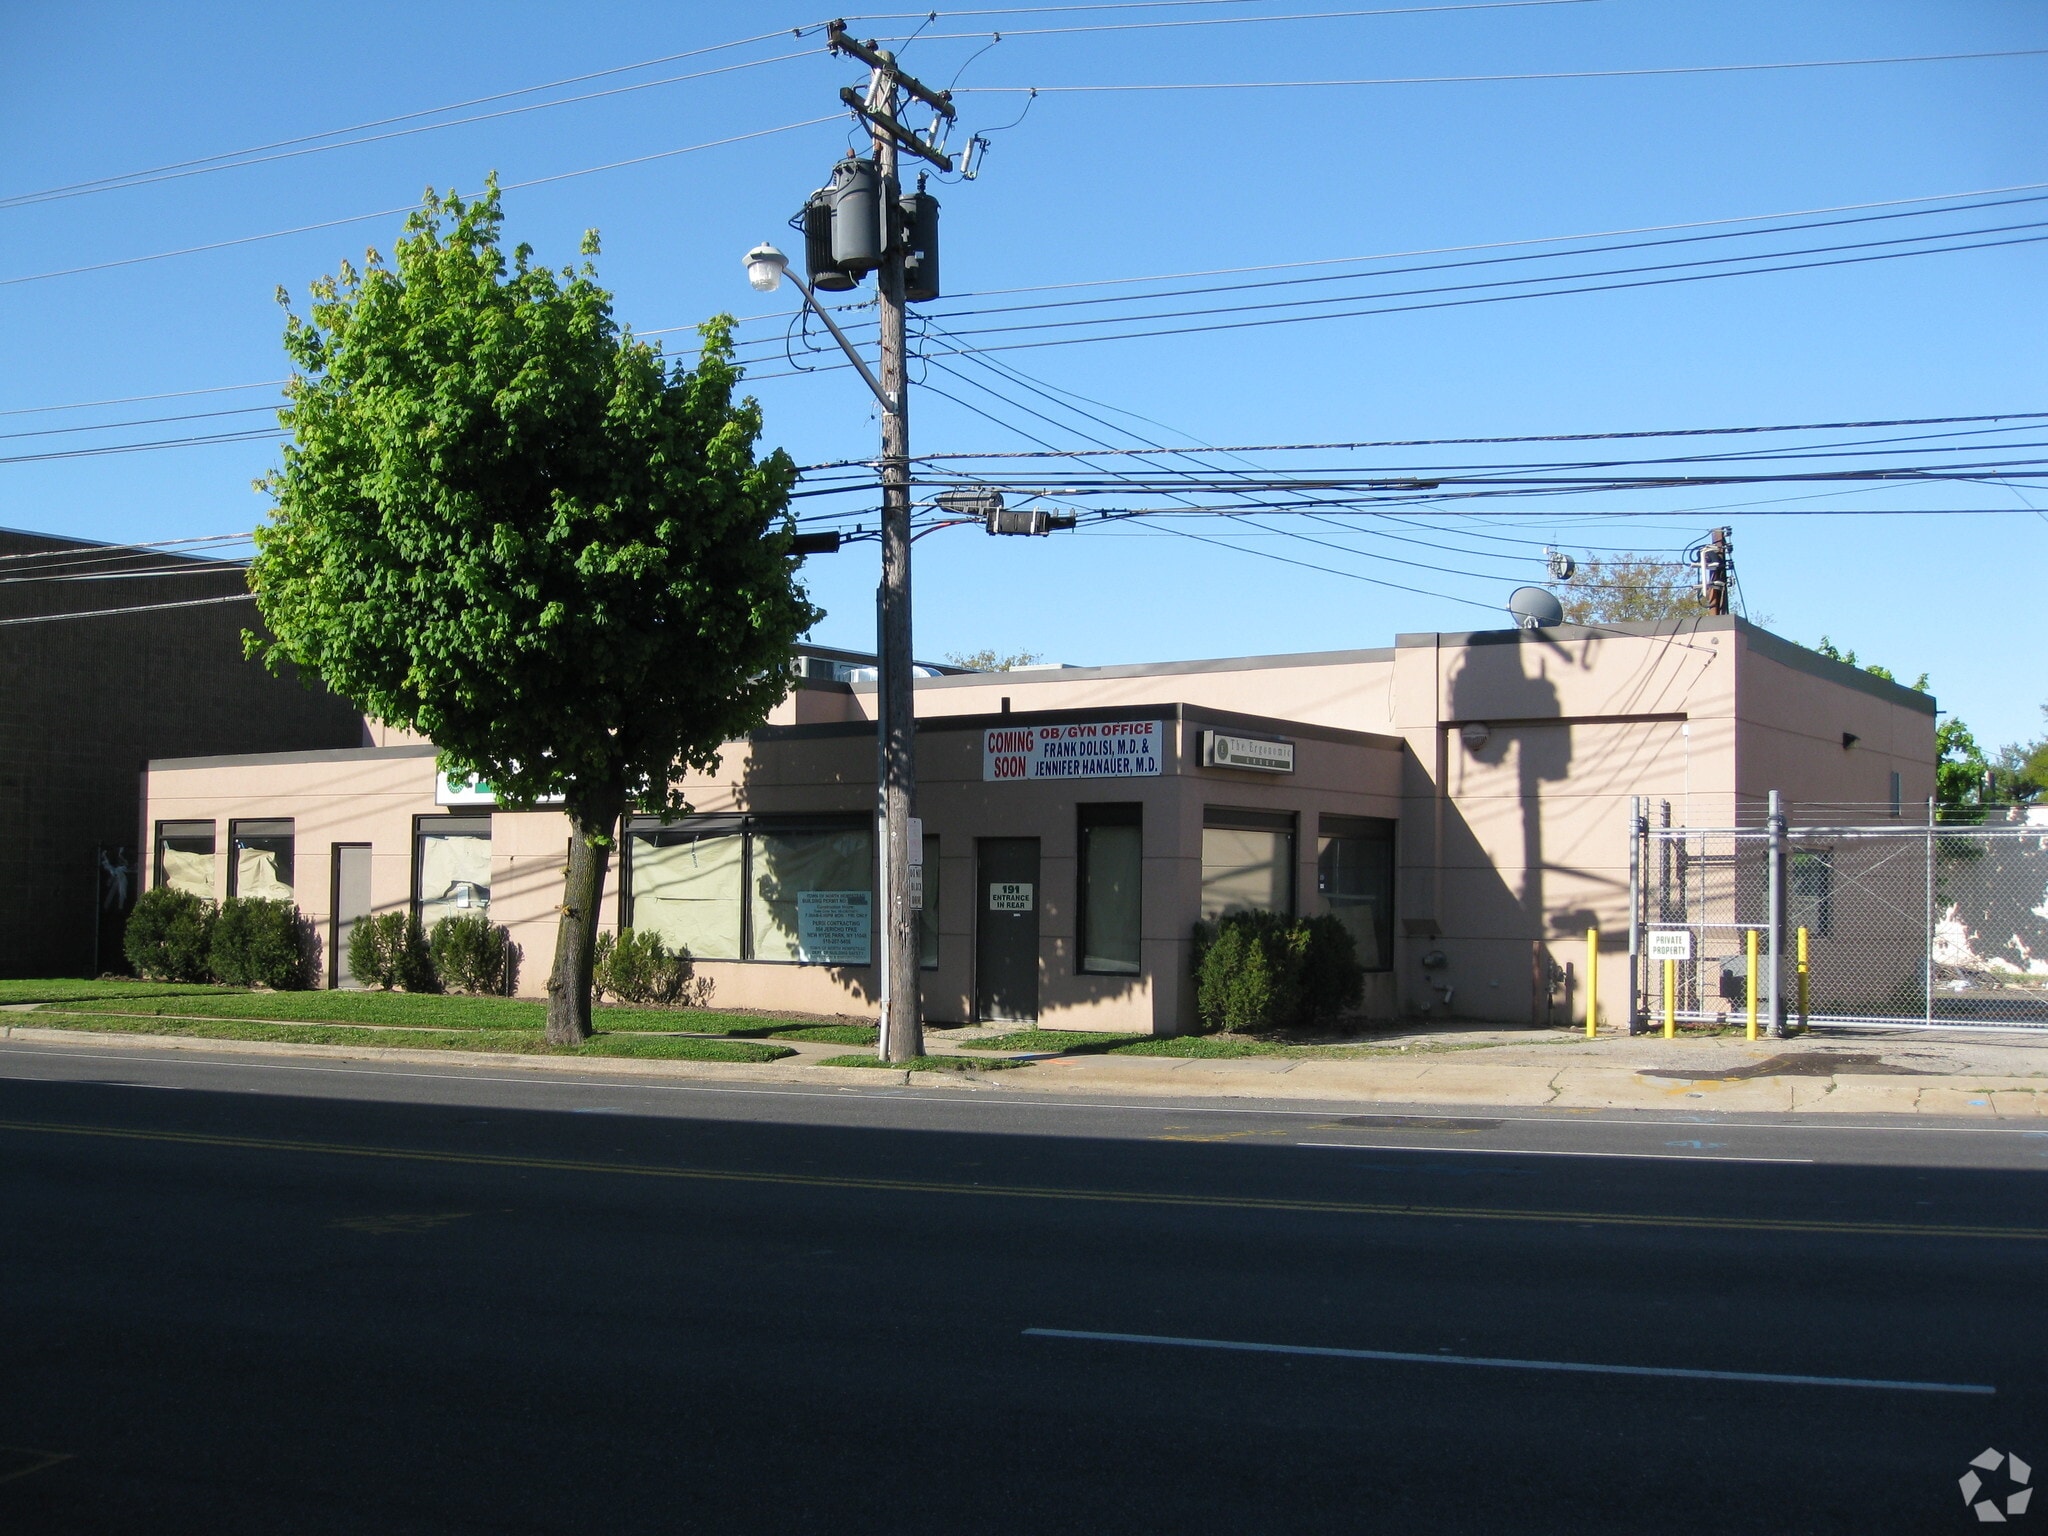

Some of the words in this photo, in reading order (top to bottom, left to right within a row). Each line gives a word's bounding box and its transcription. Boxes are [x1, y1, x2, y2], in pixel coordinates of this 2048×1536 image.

[1040, 725, 1097, 741] OB/GYN
[1101, 722, 1153, 736] OFFICE
[988, 730, 1034, 753] COMING
[1044, 741, 1077, 758] FRANK
[1079, 739, 1115, 757] DOLISI,
[1117, 739, 1139, 754] M.D.
[1142, 738, 1149, 753] &
[1231, 739, 1245, 752] The
[1249, 741, 1291, 757] Ergonomic
[994, 756, 1026, 778] SOON
[1035, 759, 1080, 776] JENNIFER
[1082, 757, 1133, 775] HANAUER,
[1136, 756, 1158, 772] M.D.
[1002, 885, 1020, 894] 191
[1656, 935, 1682, 944] PRIVATE
[1653, 946, 1686, 955] PROPERTY
